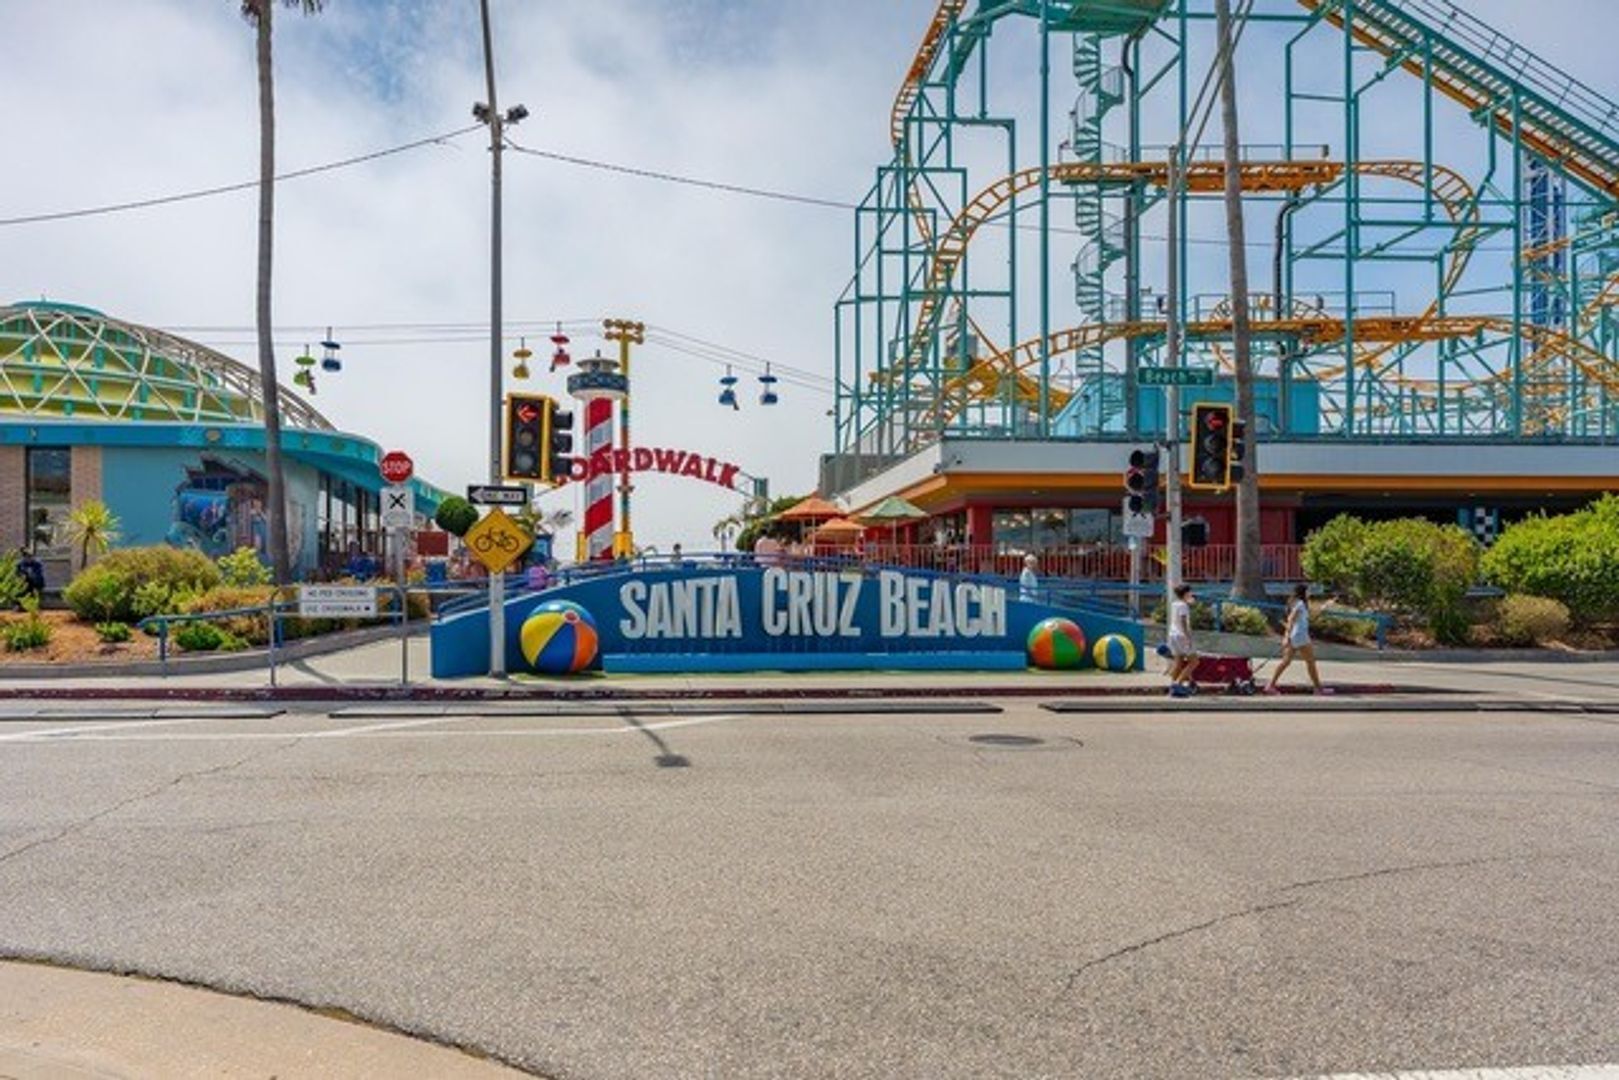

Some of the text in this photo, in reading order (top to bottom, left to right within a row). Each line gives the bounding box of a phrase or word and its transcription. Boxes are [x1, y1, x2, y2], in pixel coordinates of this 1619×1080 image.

[1145, 369, 1187, 384] Beach
[382, 459, 411, 474] STOP
[556, 447, 740, 488] OARDWALK
[619, 566, 1006, 639] SANTA CRUZ BEACH
